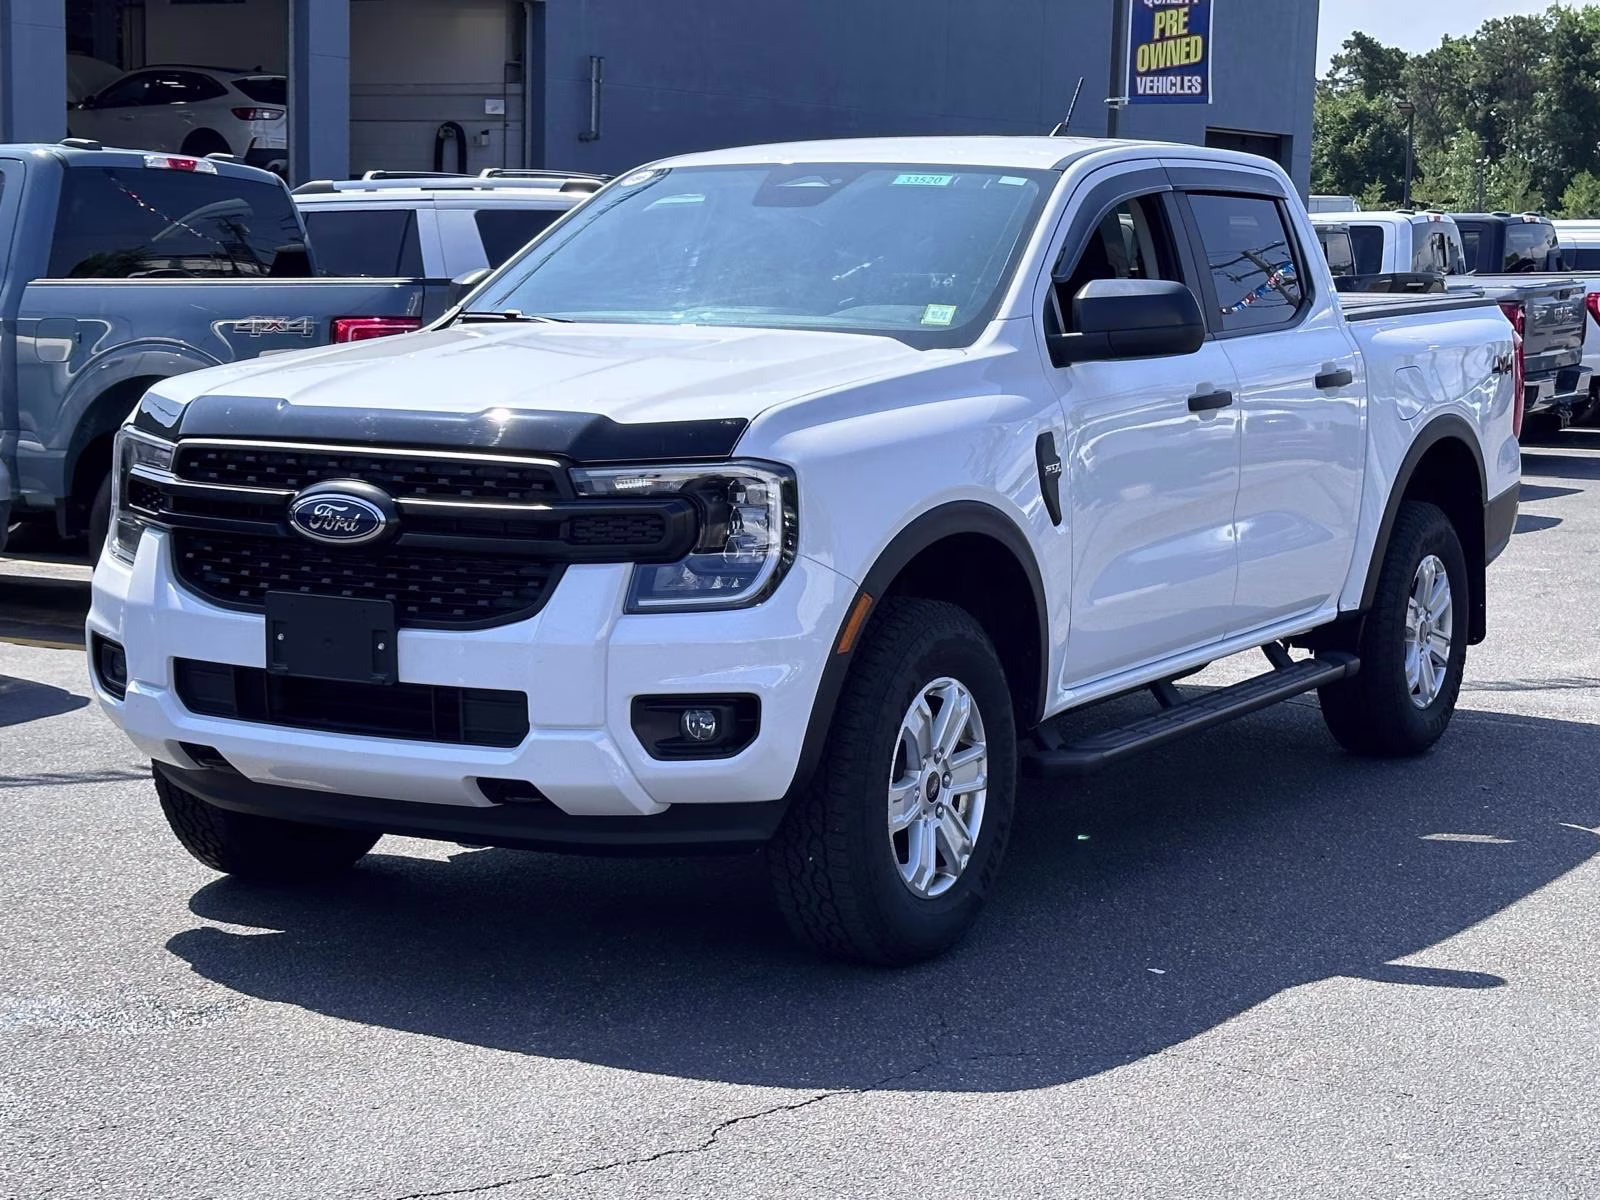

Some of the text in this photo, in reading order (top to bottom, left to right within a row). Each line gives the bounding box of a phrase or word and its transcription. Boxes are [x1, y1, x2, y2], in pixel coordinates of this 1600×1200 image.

[1153, 7, 1190, 40] PRE
[1136, 35, 1203, 72] OWNED
[1136, 75, 1202, 95] VEHICLES
[902, 176, 943, 184] 33520
[308, 503, 361, 532] Ford
